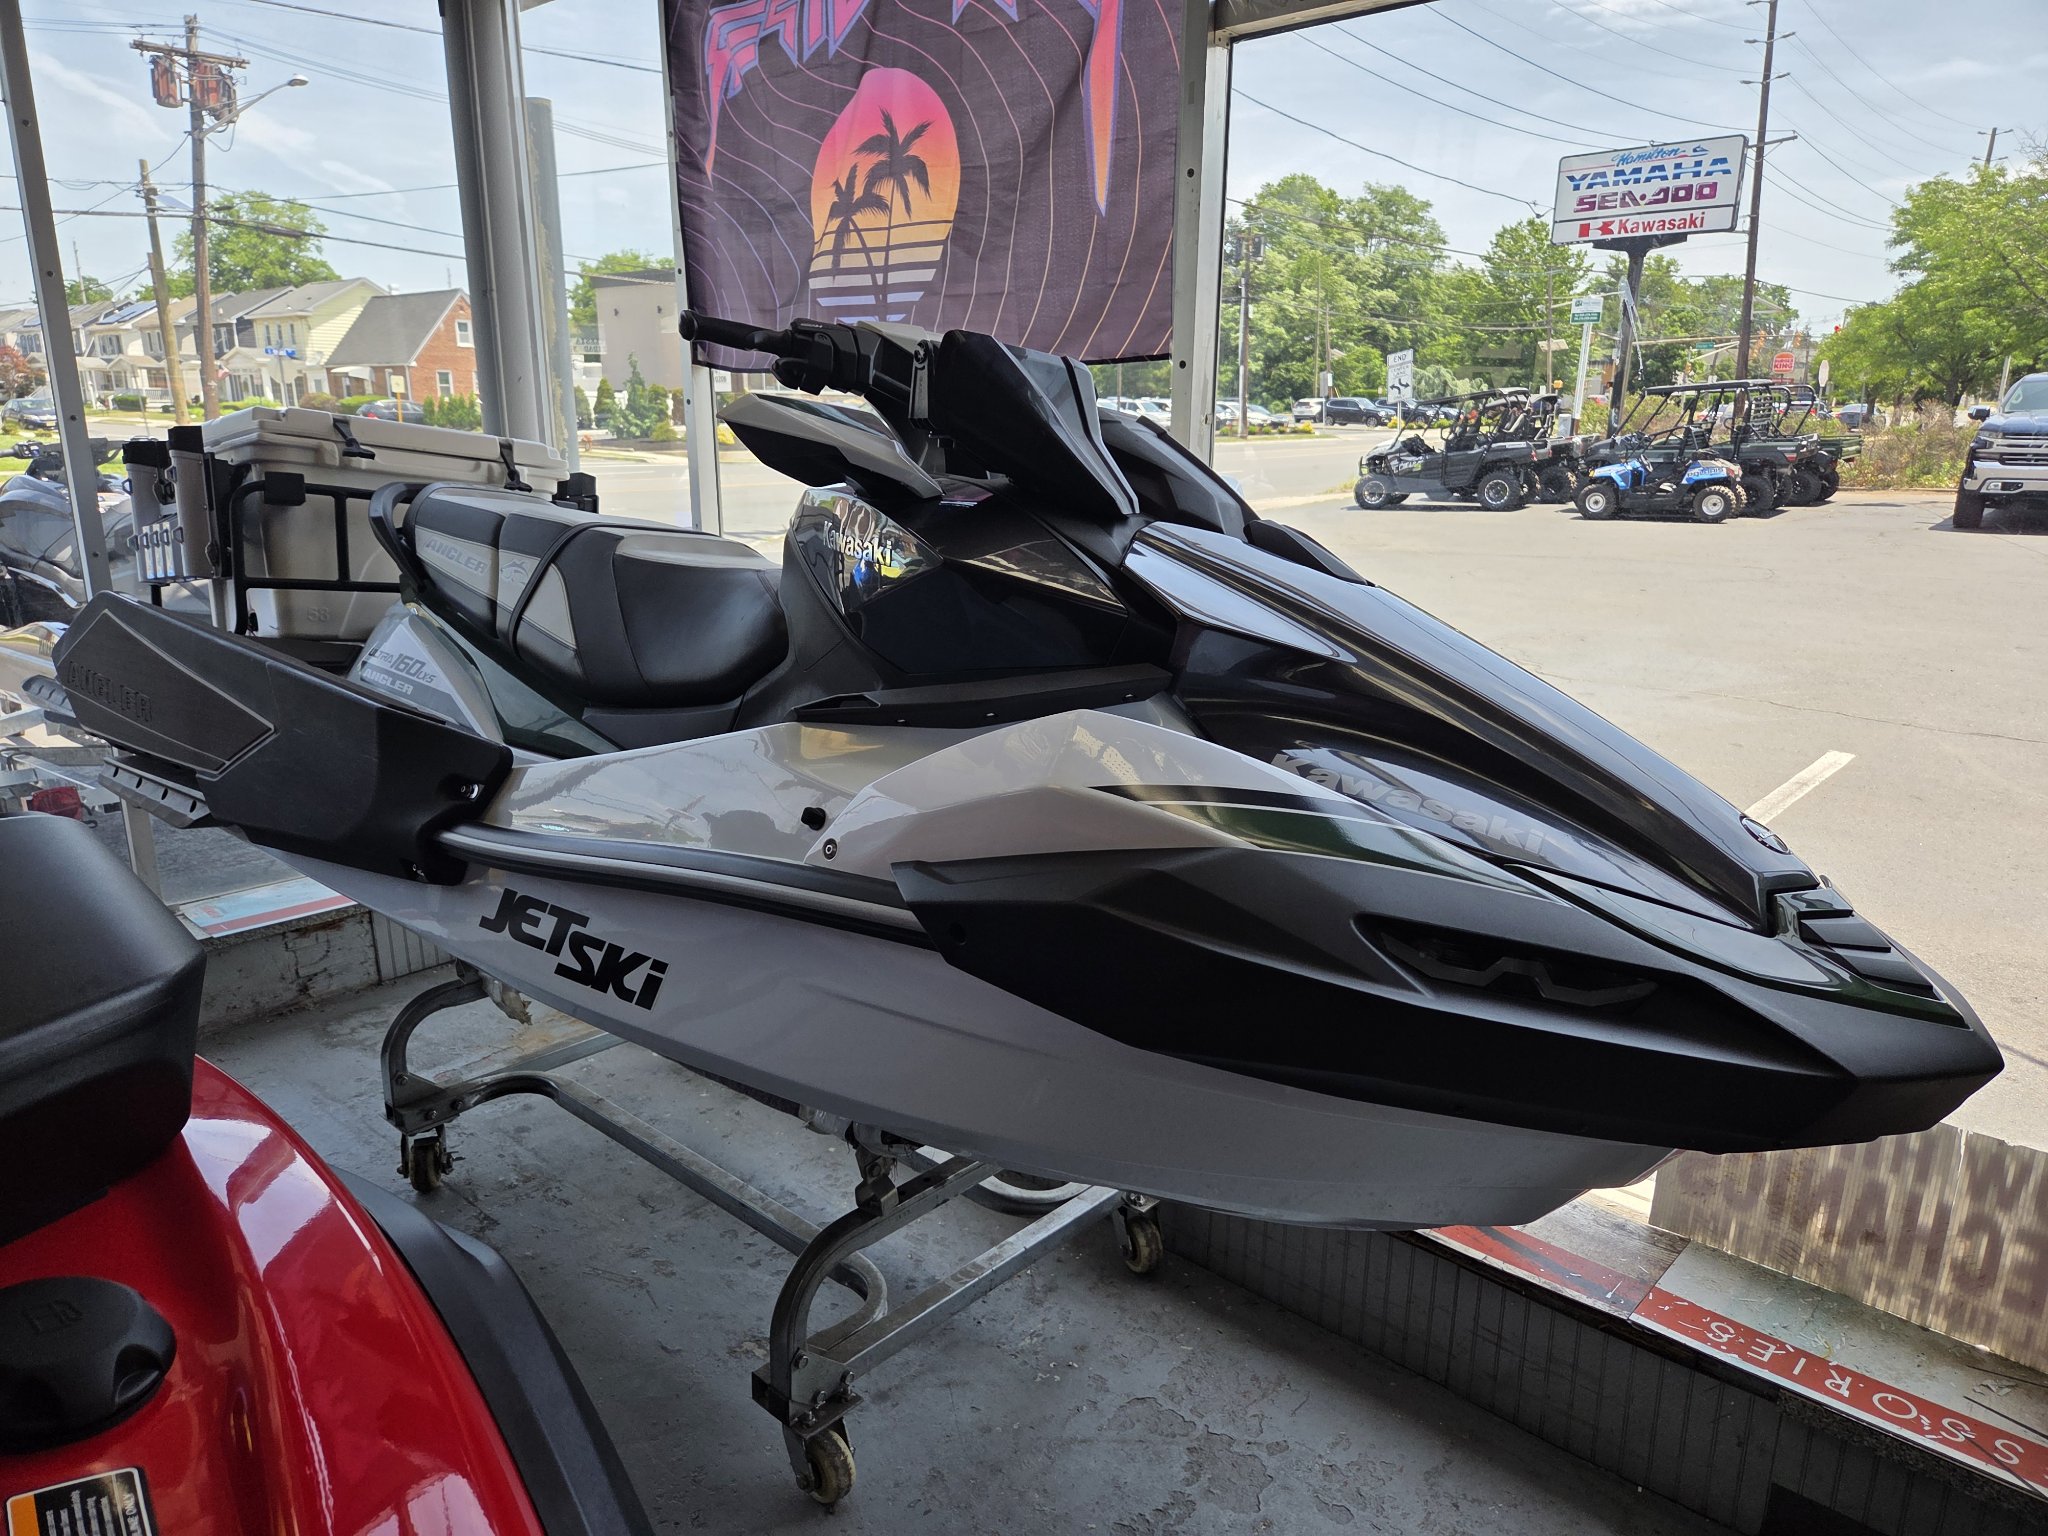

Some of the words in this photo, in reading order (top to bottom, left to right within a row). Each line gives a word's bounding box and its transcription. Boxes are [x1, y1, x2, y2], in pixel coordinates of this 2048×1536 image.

[1566, 157, 1732, 191] YAMAHA
[1611, 145, 1686, 167] Hamilton
[1617, 211, 1706, 235] Kawasaki
[1393, 353, 1407, 363] END
[424, 537, 489, 575] ANGLER
[822, 520, 893, 568] Kawasaki
[368, 647, 395, 665] ULTRA
[389, 653, 427, 678] 160
[66, 660, 153, 722] ANGLER
[363, 668, 414, 695] ANGLER
[1270, 753, 1545, 855] Kawasaki
[479, 887, 590, 957] JET
[1709, 1320, 2048, 1480] SSORIES
